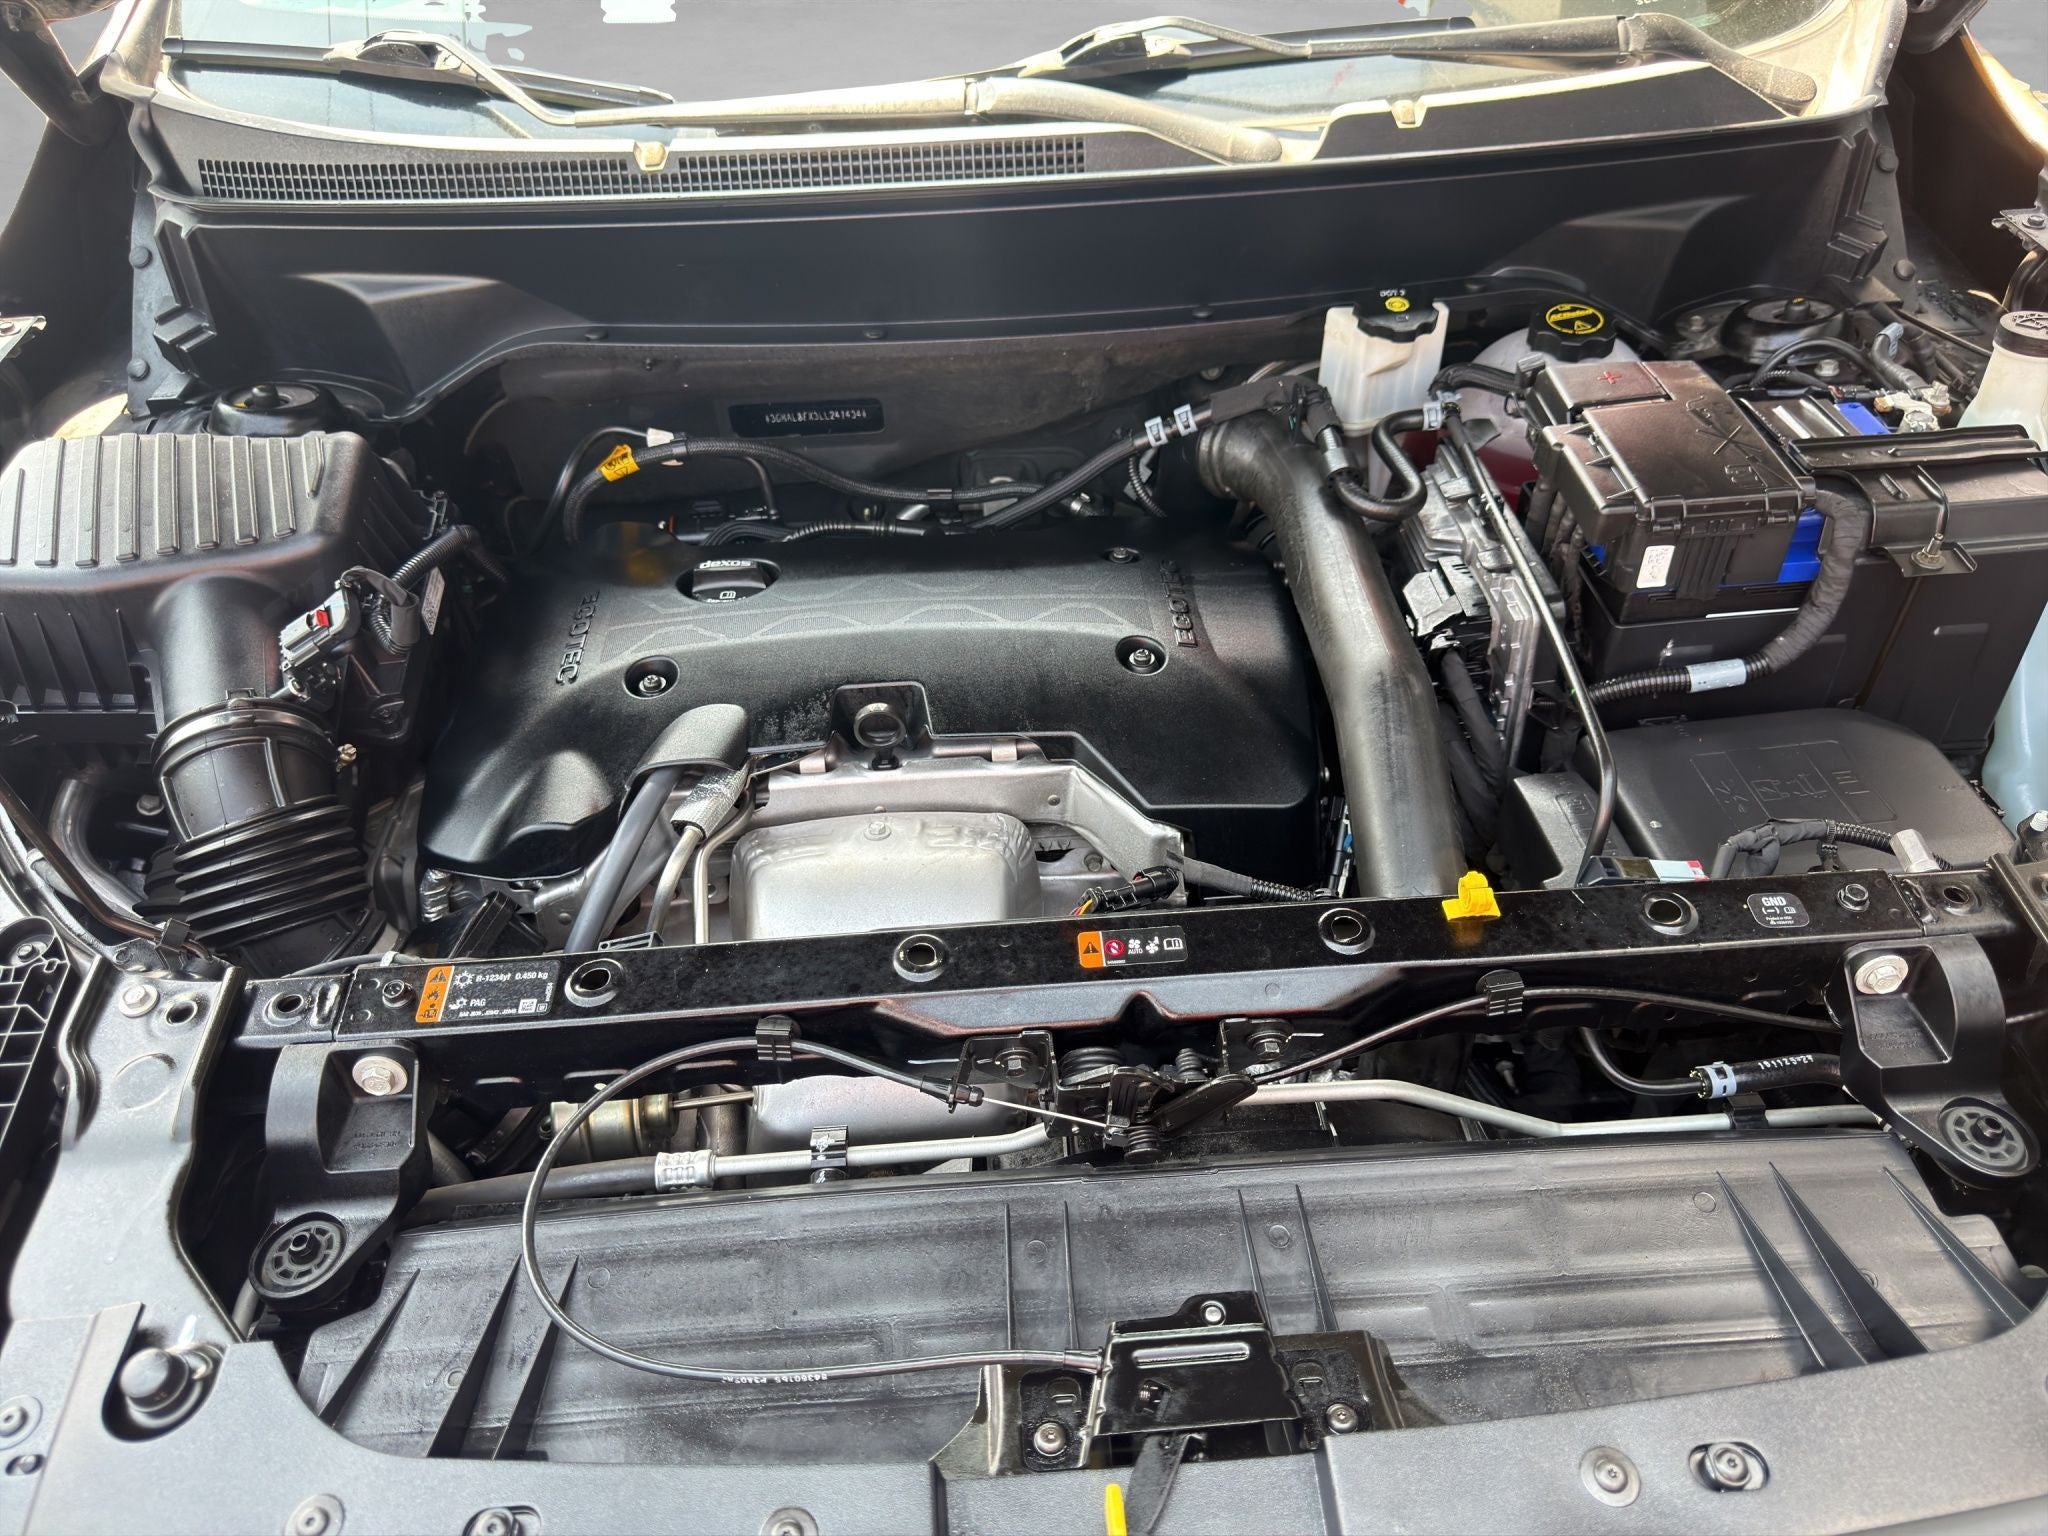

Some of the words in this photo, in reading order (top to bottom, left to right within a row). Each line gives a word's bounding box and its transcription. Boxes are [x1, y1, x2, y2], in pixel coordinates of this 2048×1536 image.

[699, 560, 751, 569] dexos
[556, 588, 600, 686] ECOTEC
[1761, 896, 1787, 906] GND
[475, 972, 512, 982] R-1234yf
[515, 972, 537, 980] 0.450
[538, 971, 548, 979] kg
[470, 998, 486, 1007] PAG
